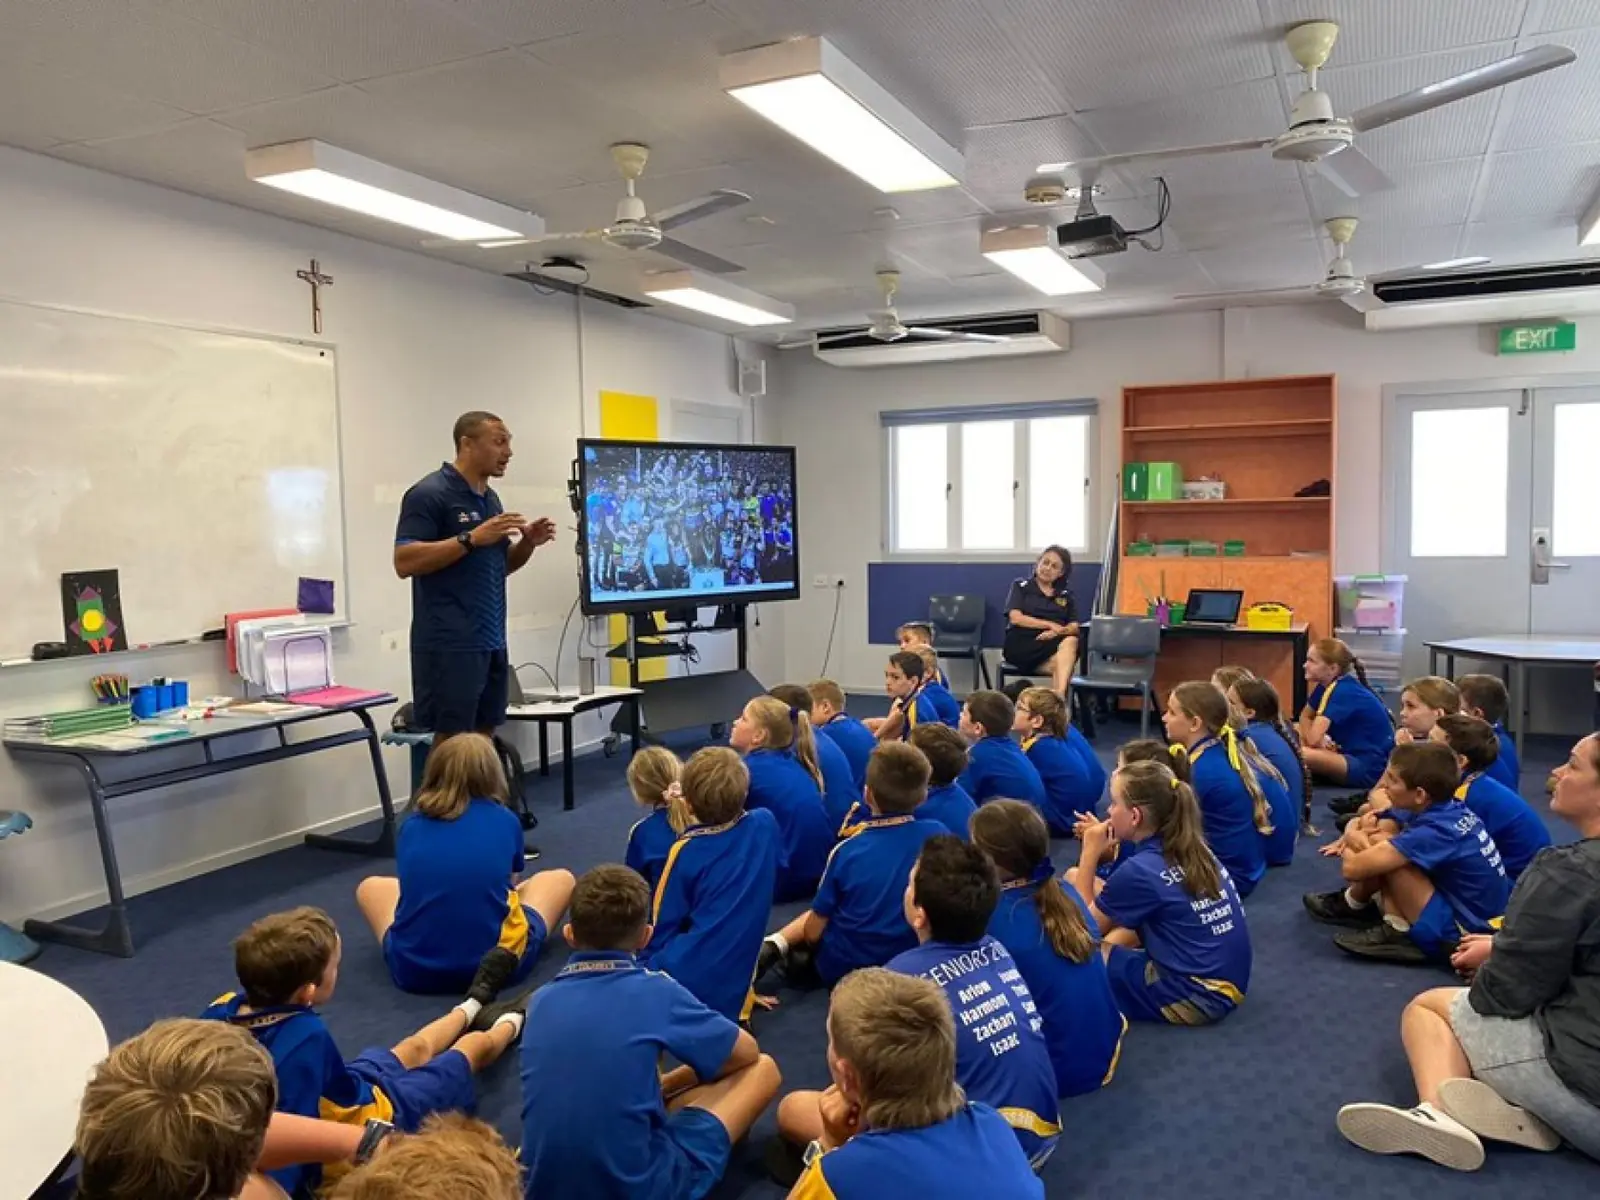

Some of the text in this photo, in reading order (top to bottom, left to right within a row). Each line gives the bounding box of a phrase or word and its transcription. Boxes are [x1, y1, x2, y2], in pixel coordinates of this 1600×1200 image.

[1515, 327, 1558, 350] EXIT
[972, 1011, 1017, 1042] Zachary
[989, 1032, 1020, 1056] Isaac
